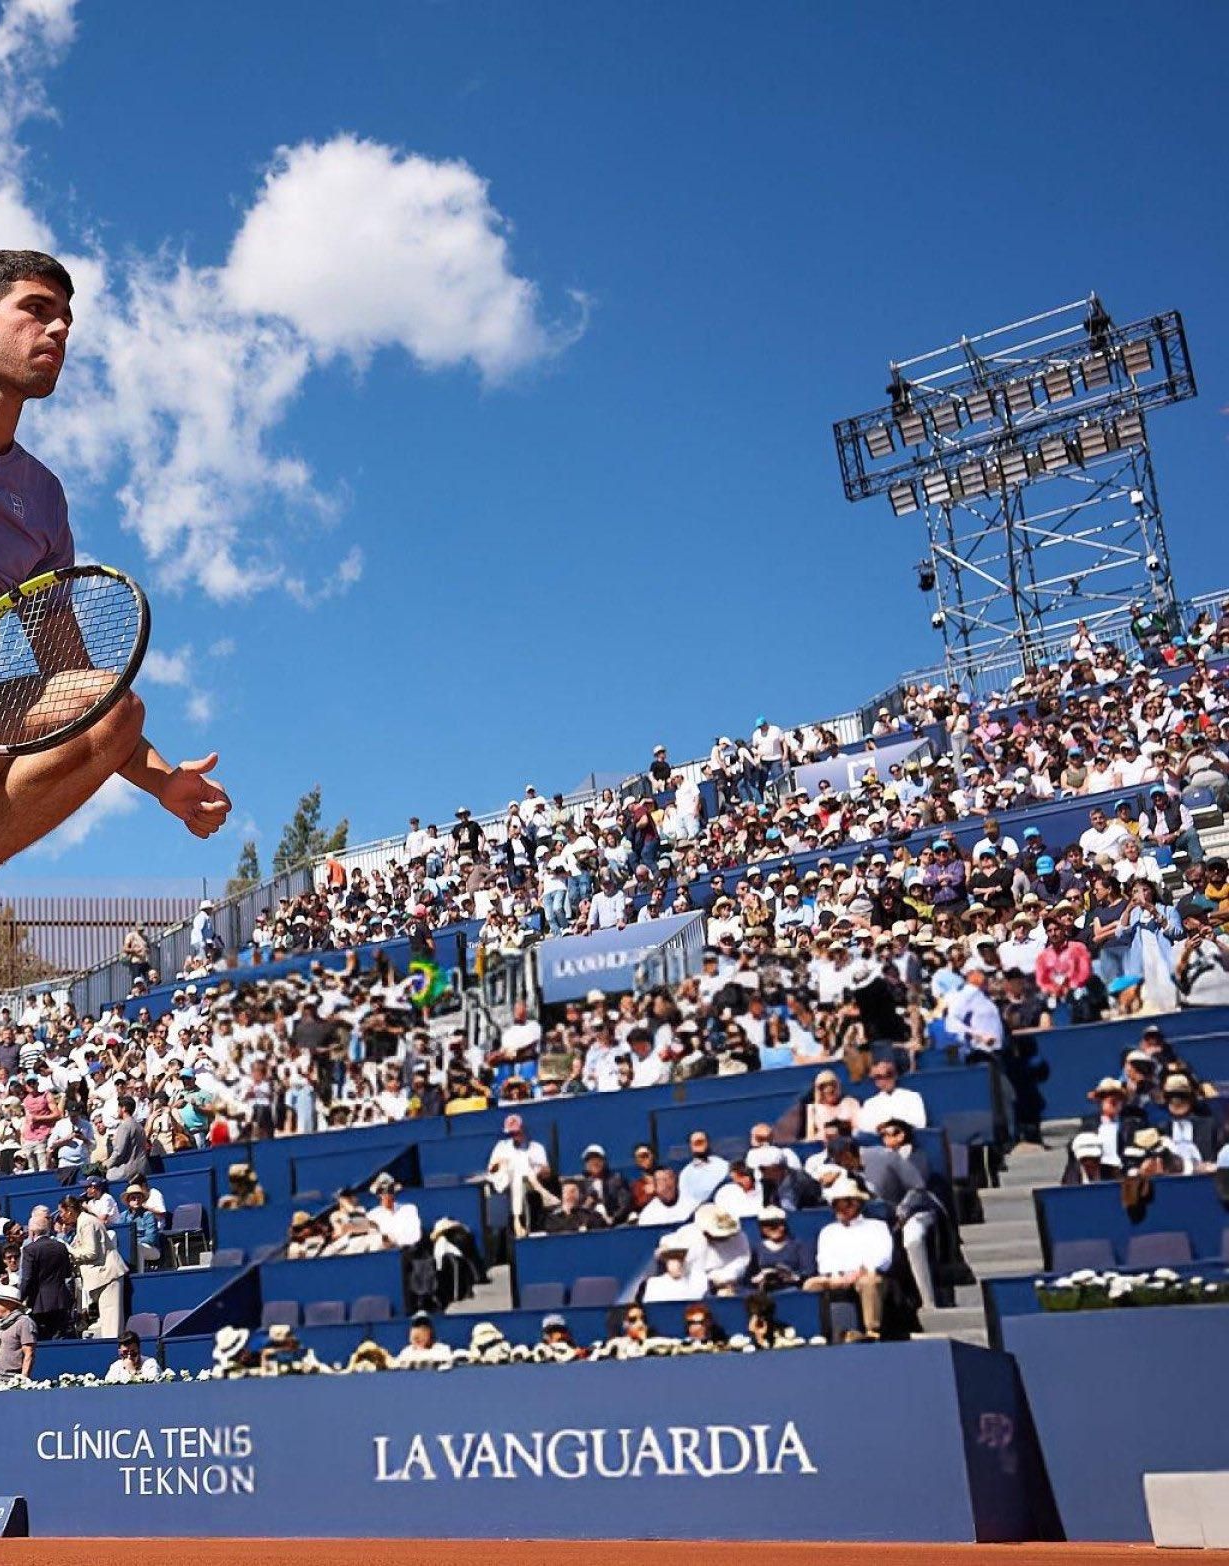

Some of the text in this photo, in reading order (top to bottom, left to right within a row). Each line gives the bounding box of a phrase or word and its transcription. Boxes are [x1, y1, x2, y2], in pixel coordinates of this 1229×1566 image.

[36, 1423, 253, 1461] CLÍNICA TENIS
[373, 1421, 819, 1481] LA VANGUARDIA
[118, 1465, 256, 1497] TEKNON
